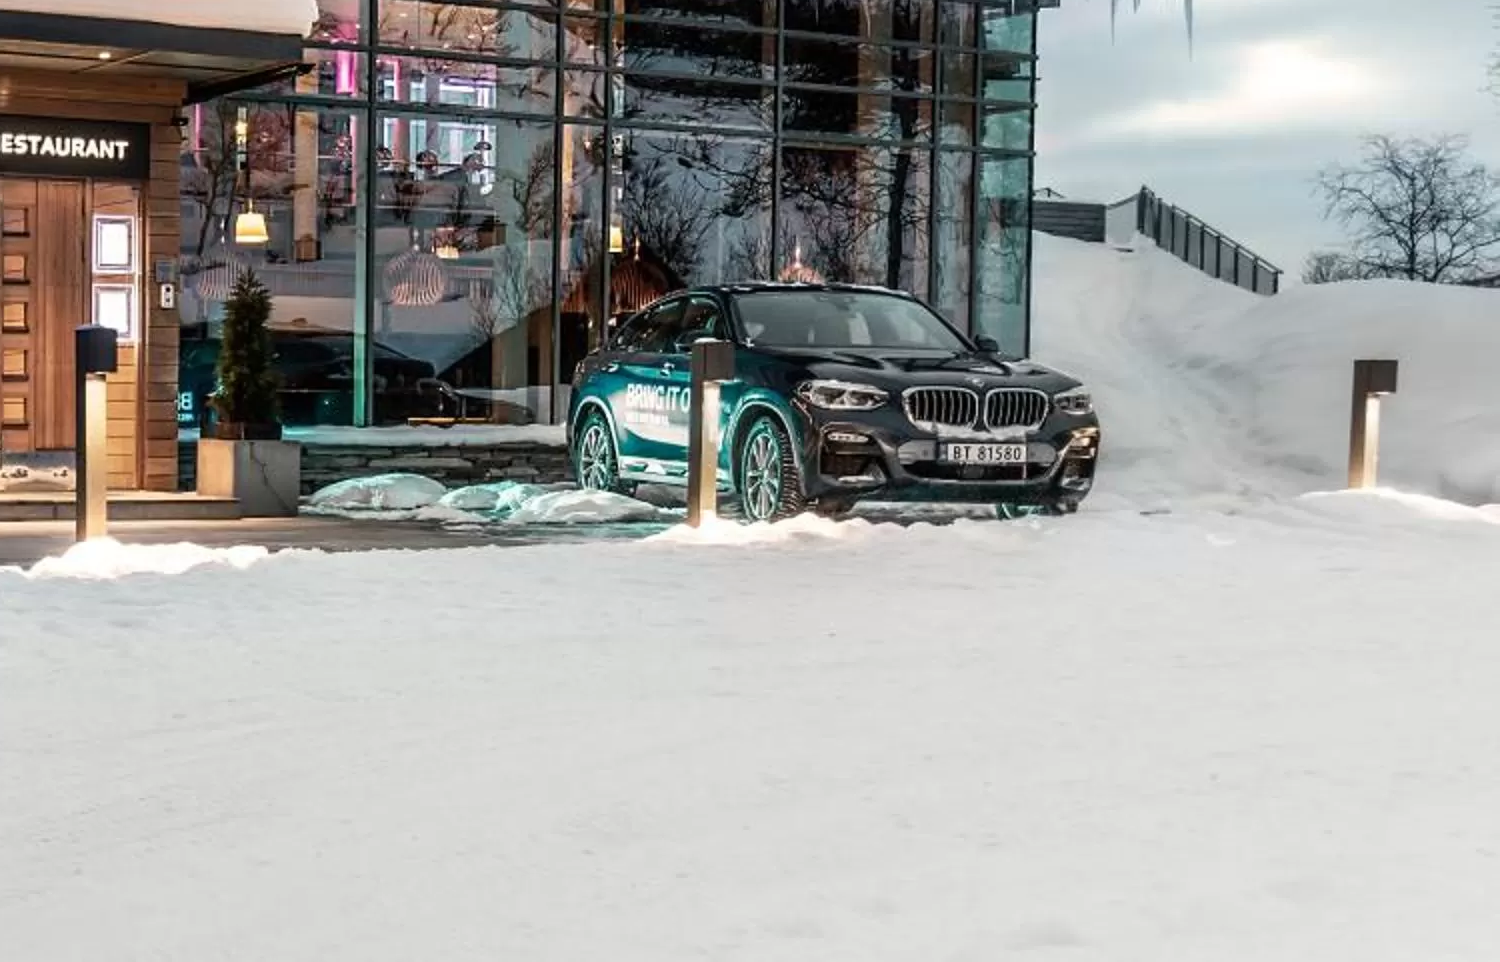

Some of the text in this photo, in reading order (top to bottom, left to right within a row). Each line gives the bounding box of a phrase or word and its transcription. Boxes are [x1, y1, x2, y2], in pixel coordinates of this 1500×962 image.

[626, 383, 666, 411] BRING
[953, 445, 1021, 461] BT 81580
